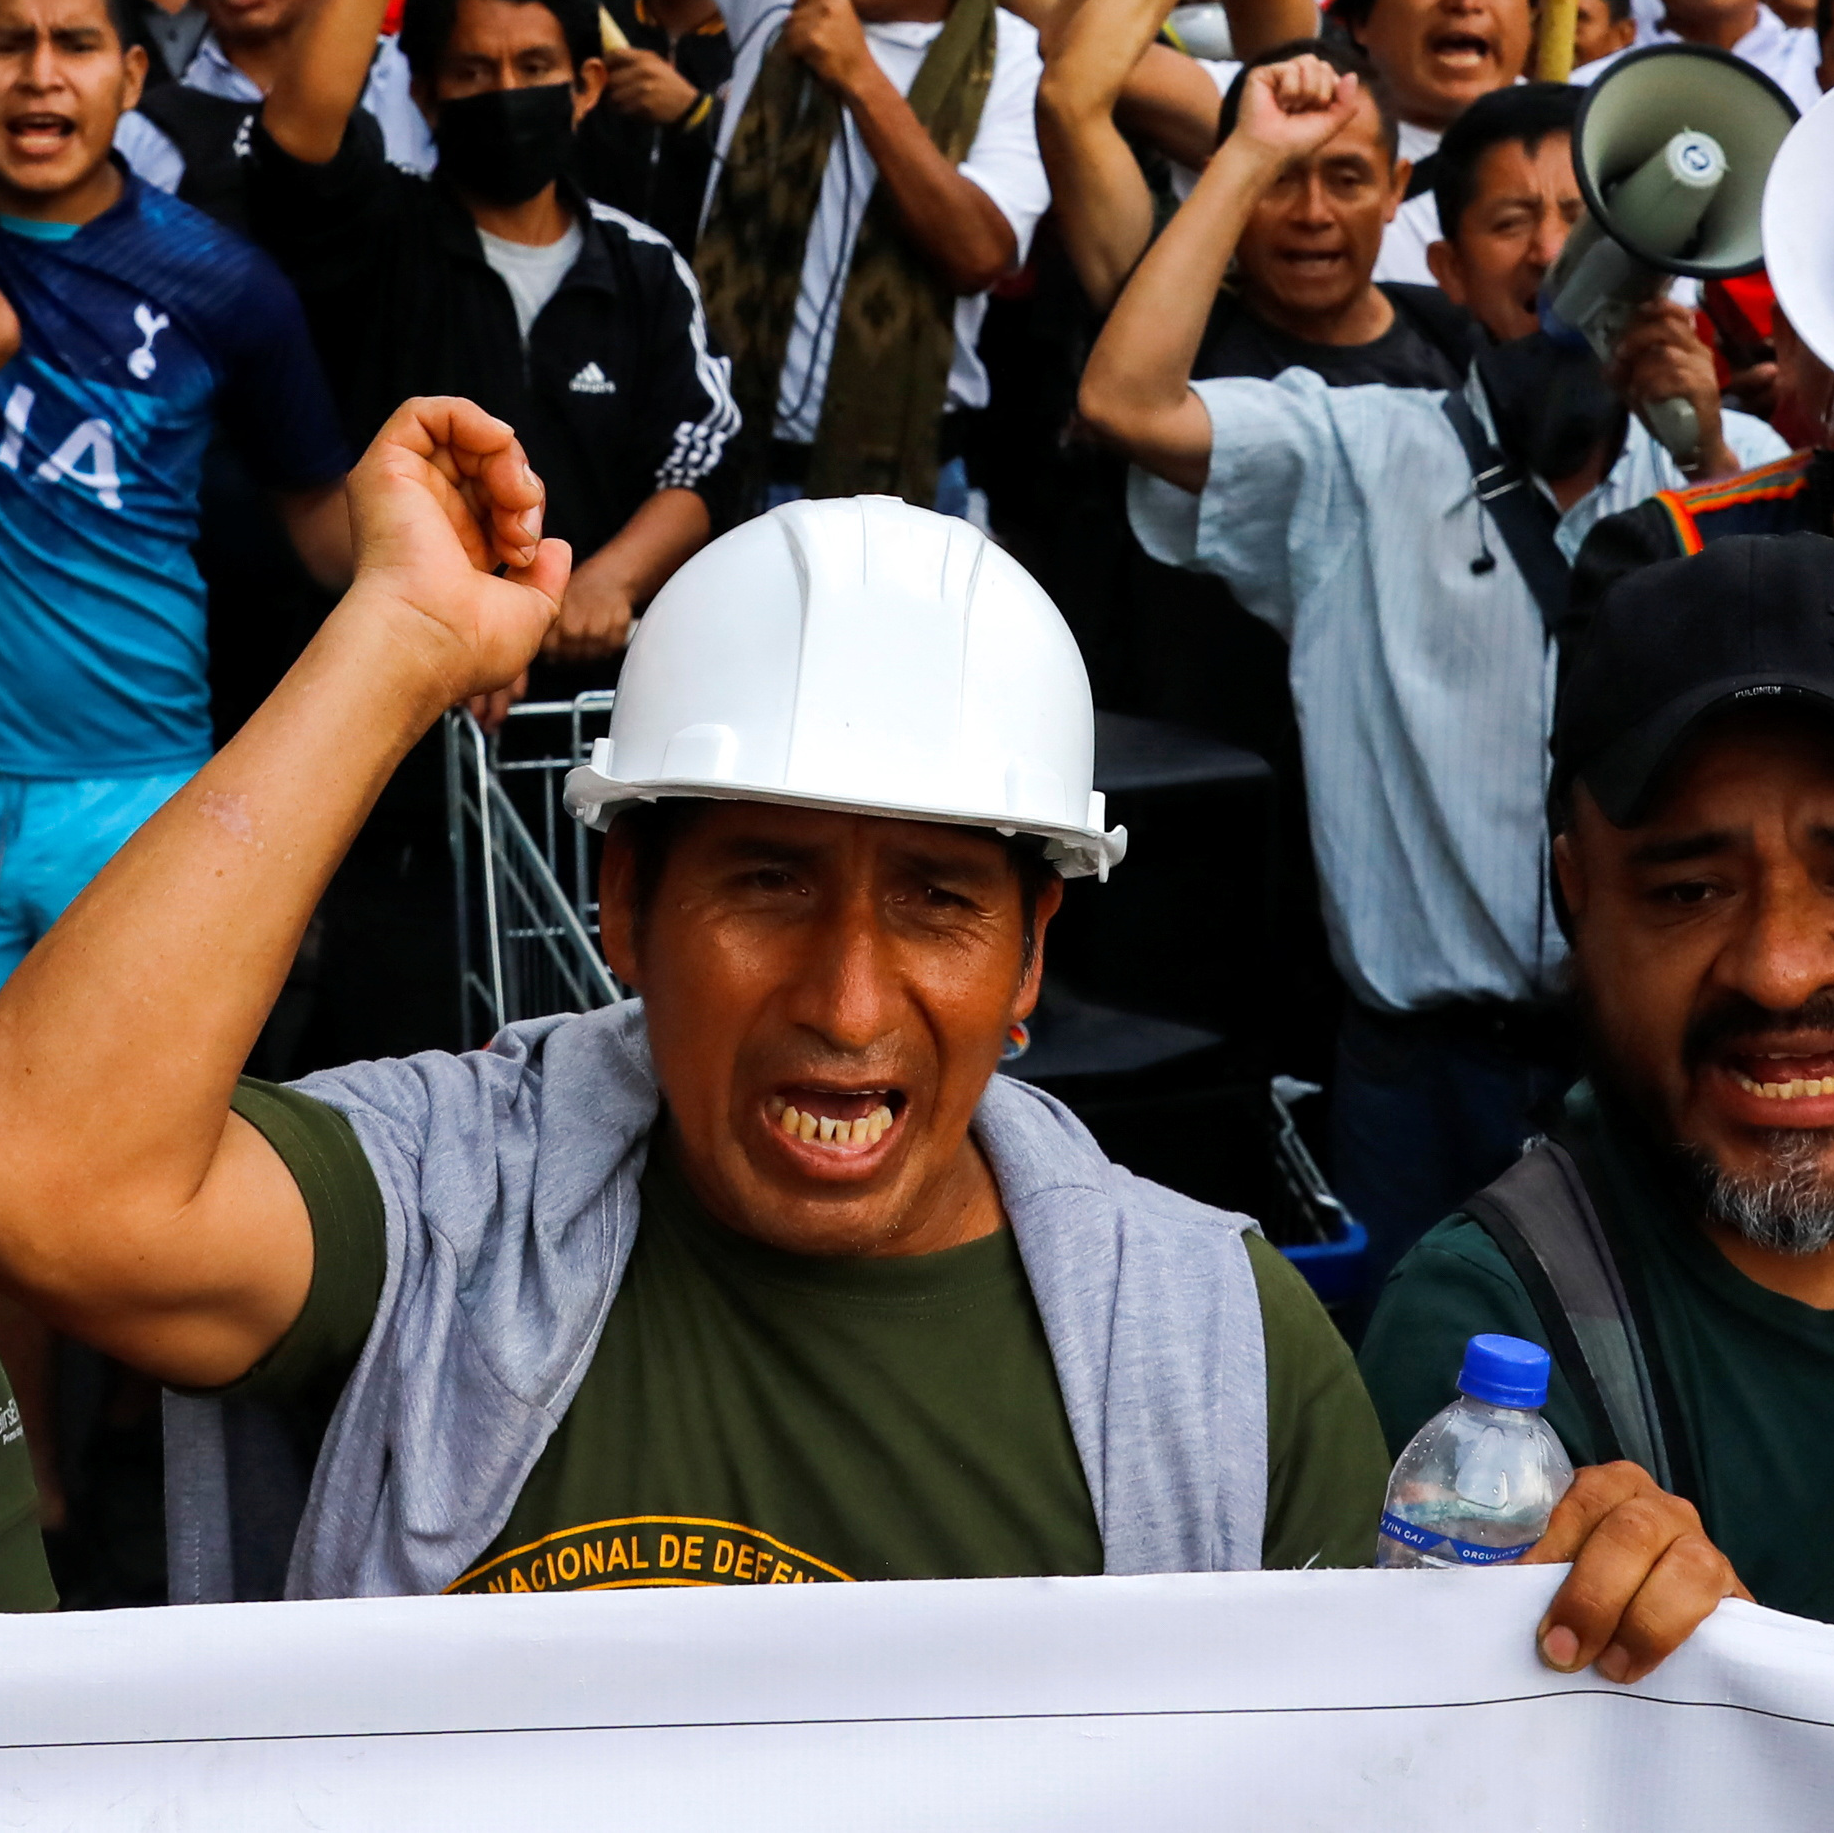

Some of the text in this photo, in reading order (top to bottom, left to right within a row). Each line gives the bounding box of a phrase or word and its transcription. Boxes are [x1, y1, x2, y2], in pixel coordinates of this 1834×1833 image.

[1386, 1521, 1402, 1535] SIN
[1404, 1529, 1426, 1545] GAS
[659, 1533, 705, 1570] DE
